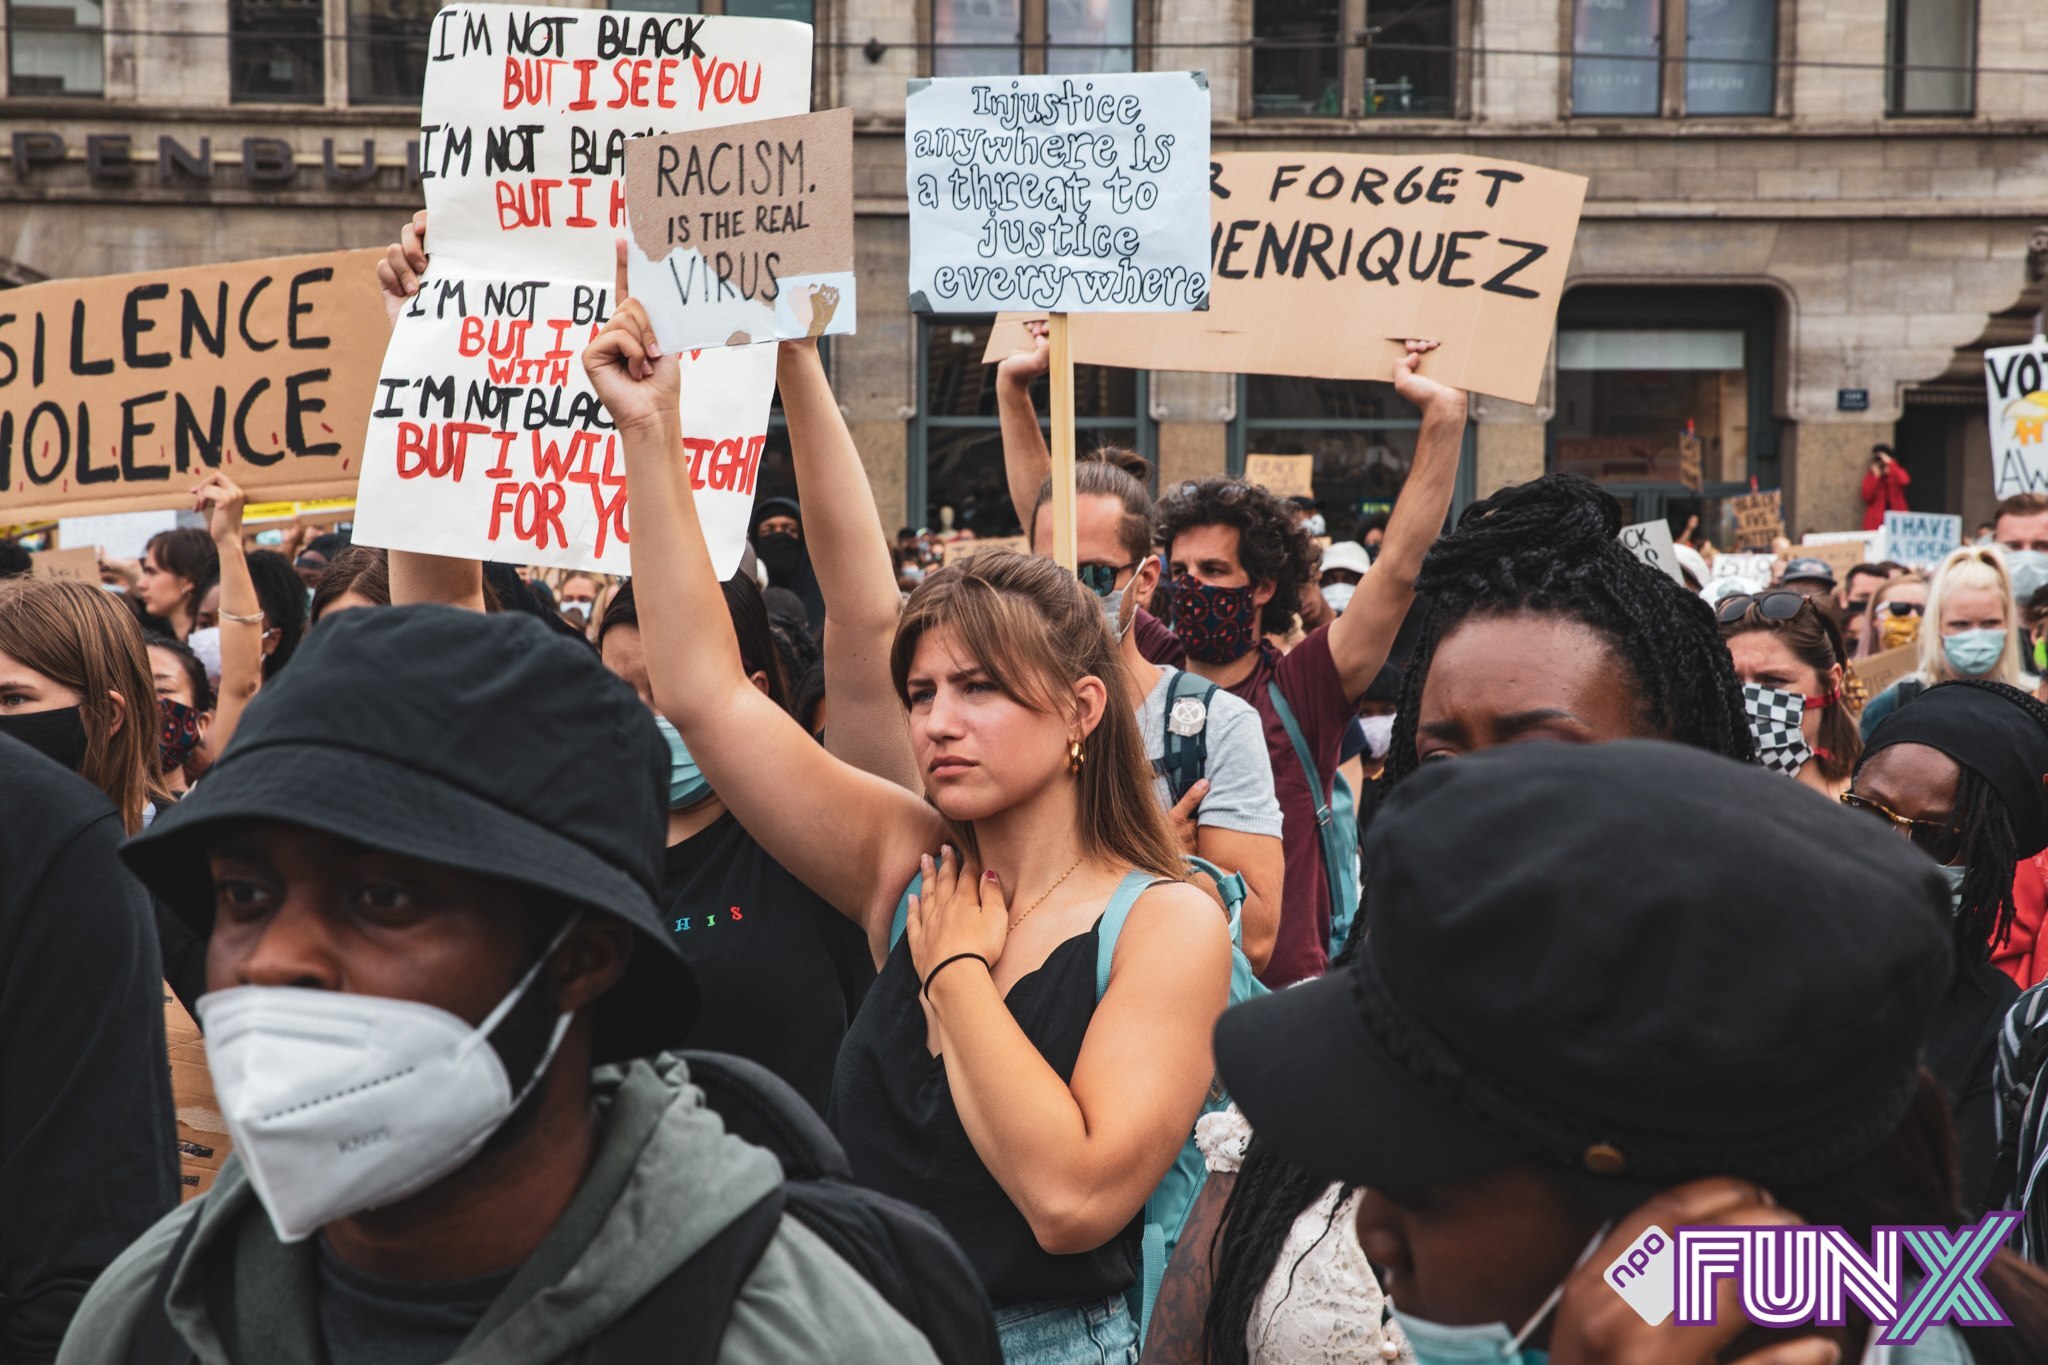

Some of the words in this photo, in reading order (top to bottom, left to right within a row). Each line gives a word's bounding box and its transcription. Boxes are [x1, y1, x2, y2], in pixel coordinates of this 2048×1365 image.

[433, 10, 492, 61] I'M
[508, 11, 578, 57] NOT
[598, 15, 706, 60] BLACK
[503, 55, 569, 111] BUT
[569, 59, 599, 111] I
[607, 57, 680, 110] SEE
[692, 54, 762, 111] YOU
[972, 80, 1142, 130] Injustice
[420, 123, 472, 179] I'M
[485, 124, 545, 177] NOT
[570, 125, 669, 177] BLA
[657, 139, 816, 197] RACISM.
[914, 127, 1117, 169] anywhere
[1130, 124, 1176, 173] is
[495, 178, 563, 231] BUT
[566, 178, 598, 228] I
[918, 173, 939, 209] a
[948, 163, 1091, 214] threat
[1103, 167, 1159, 214] to
[1269, 165, 1525, 208] FORGET
[667, 214, 690, 244] IS
[700, 210, 745, 241] THE
[755, 201, 810, 234] REAL
[977, 210, 1140, 257] justice
[669, 250, 780, 305] VIRUS
[934, 257, 1206, 308] everywhere
[1211, 219, 1549, 299] ENRIQUEZ
[406, 278, 467, 319] I'M
[484, 281, 550, 324] NOT
[458, 316, 534, 360] BUT
[545, 319, 574, 359] I
[488, 358, 569, 387] WITH
[373, 375, 455, 418] I'M
[464, 378, 524, 431] NOT
[523, 385, 617, 431] BLAC
[396, 421, 491, 482] BUT
[485, 431, 518, 478] I
[532, 429, 628, 485] WIL
[682, 435, 767, 496] IGHT
[487, 481, 569, 550] FOR
[591, 482, 630, 559] YO
[1891, 518, 1897, 534] I
[1902, 518, 1951, 539] HAVE
[1889, 541, 1902, 558] A
[1905, 540, 1950, 561] DREA
